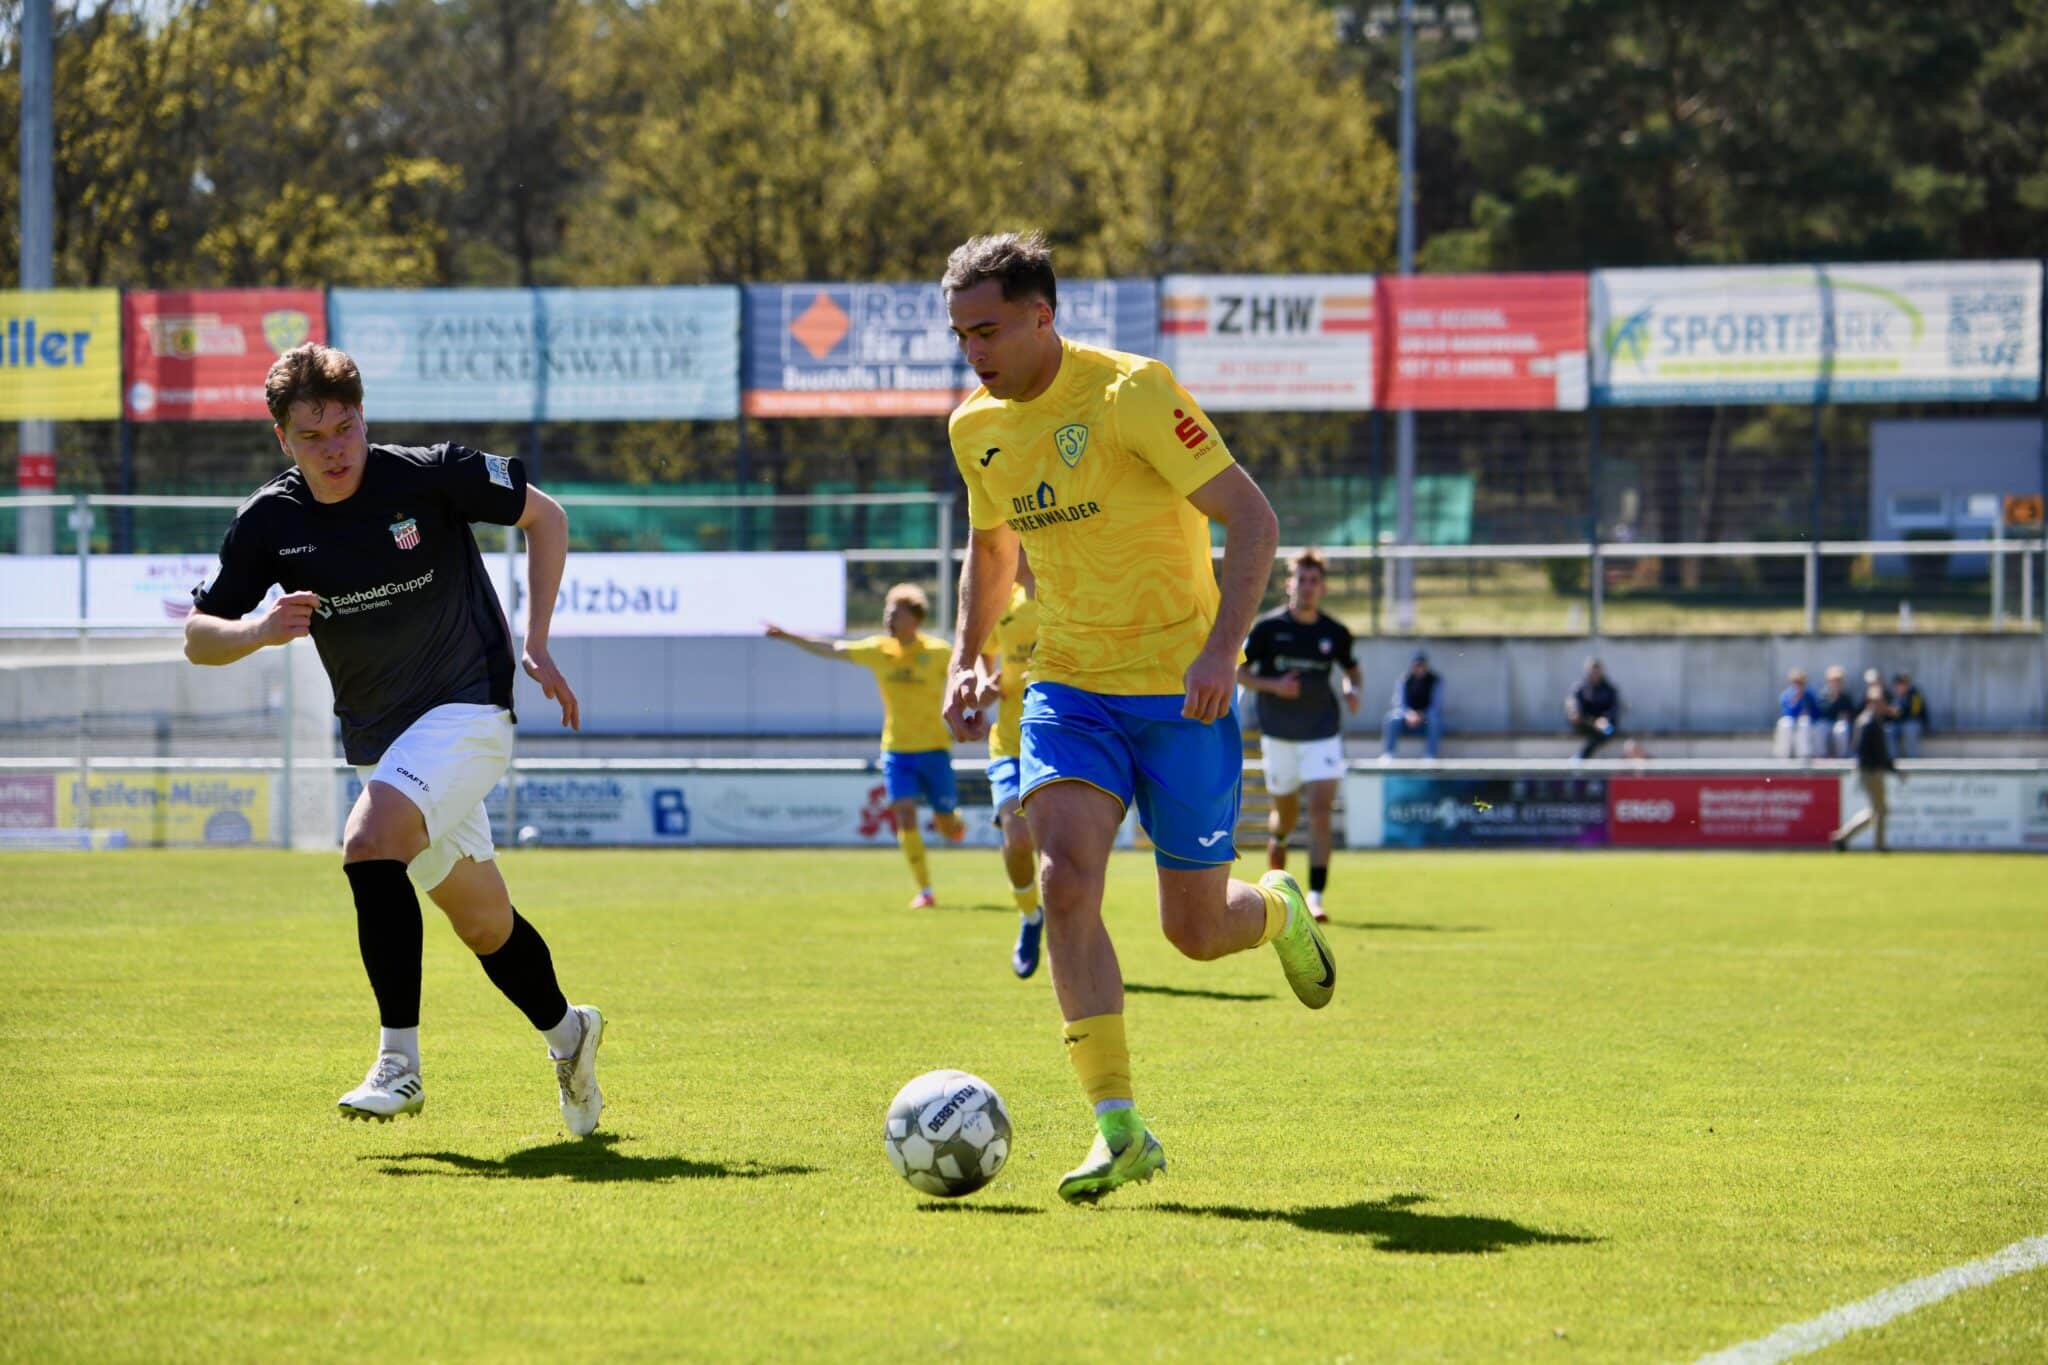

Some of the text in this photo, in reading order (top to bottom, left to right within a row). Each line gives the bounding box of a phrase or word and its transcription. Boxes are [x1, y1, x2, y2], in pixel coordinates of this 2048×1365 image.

[1215, 297, 1315, 333] ZHW
[0, 319, 91, 367] ller
[1660, 311, 1893, 355] SPORTPRK
[1012, 494, 1036, 514] DIE
[279, 546, 308, 556] CRAFT
[396, 767, 424, 786] CRAFT
[1616, 800, 1674, 821] ERGO
